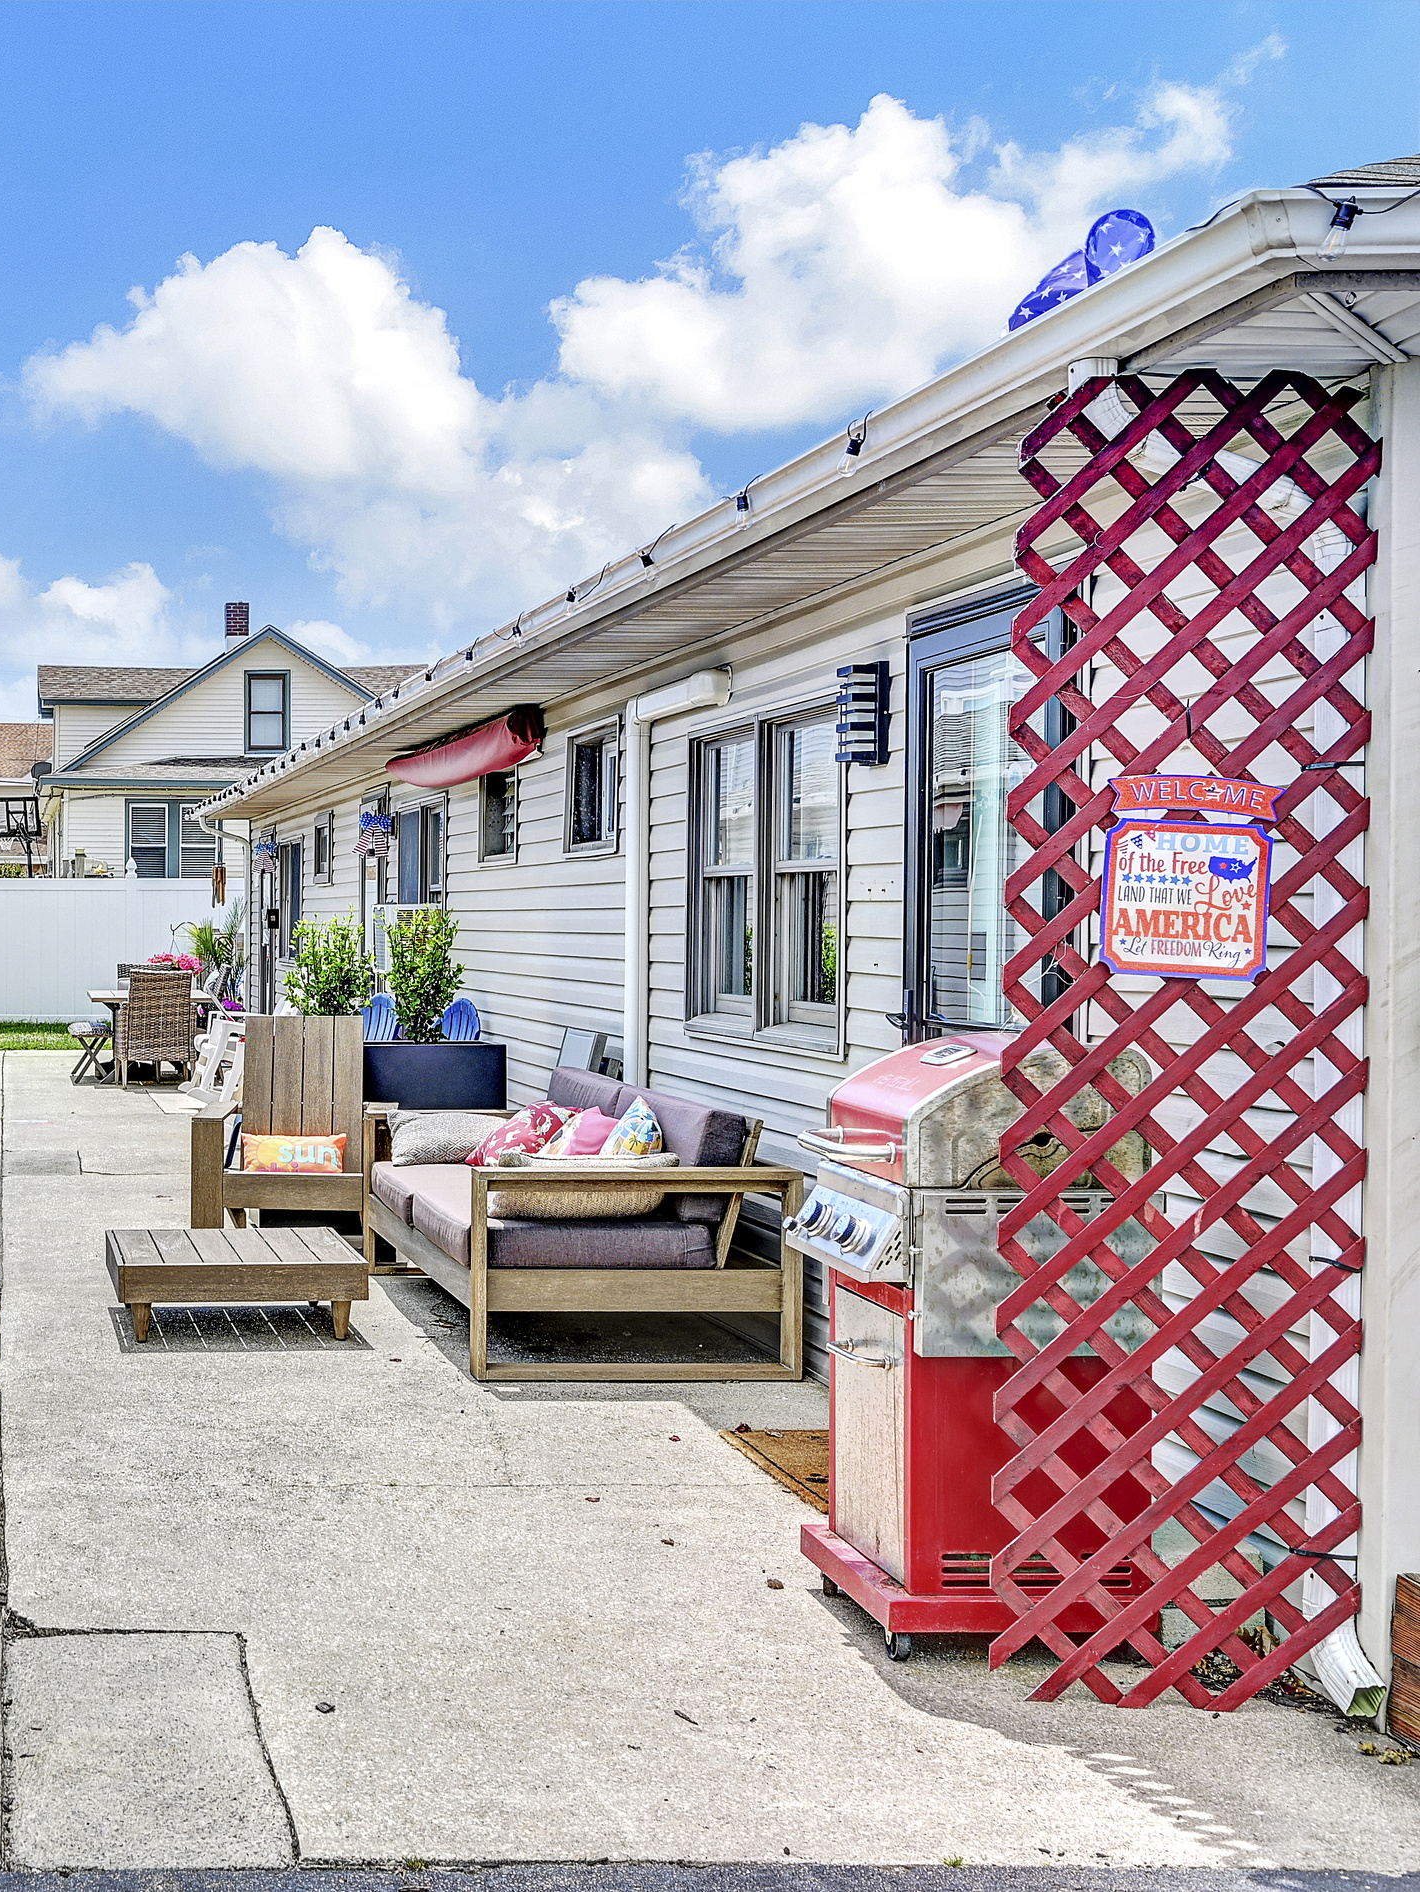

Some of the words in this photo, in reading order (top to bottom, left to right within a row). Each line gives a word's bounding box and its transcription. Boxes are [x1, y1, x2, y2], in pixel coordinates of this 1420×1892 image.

[1130, 780, 1265, 810] WELCOME
[1155, 832, 1249, 855] HOME
[1119, 851, 1134, 874] of
[1139, 852, 1167, 873] the
[1172, 852, 1209, 875] Free
[1118, 885, 1145, 903] LAND
[1149, 886, 1175, 905] THAT
[1177, 888, 1192, 906] WE
[1194, 875, 1257, 913] Love
[1112, 907, 1253, 944] AMERICA
[1123, 936, 1148, 956] Let
[1151, 939, 1202, 958] FREEDOM
[1203, 941, 1242, 969] Ring
[278, 1144, 339, 1168] sun
